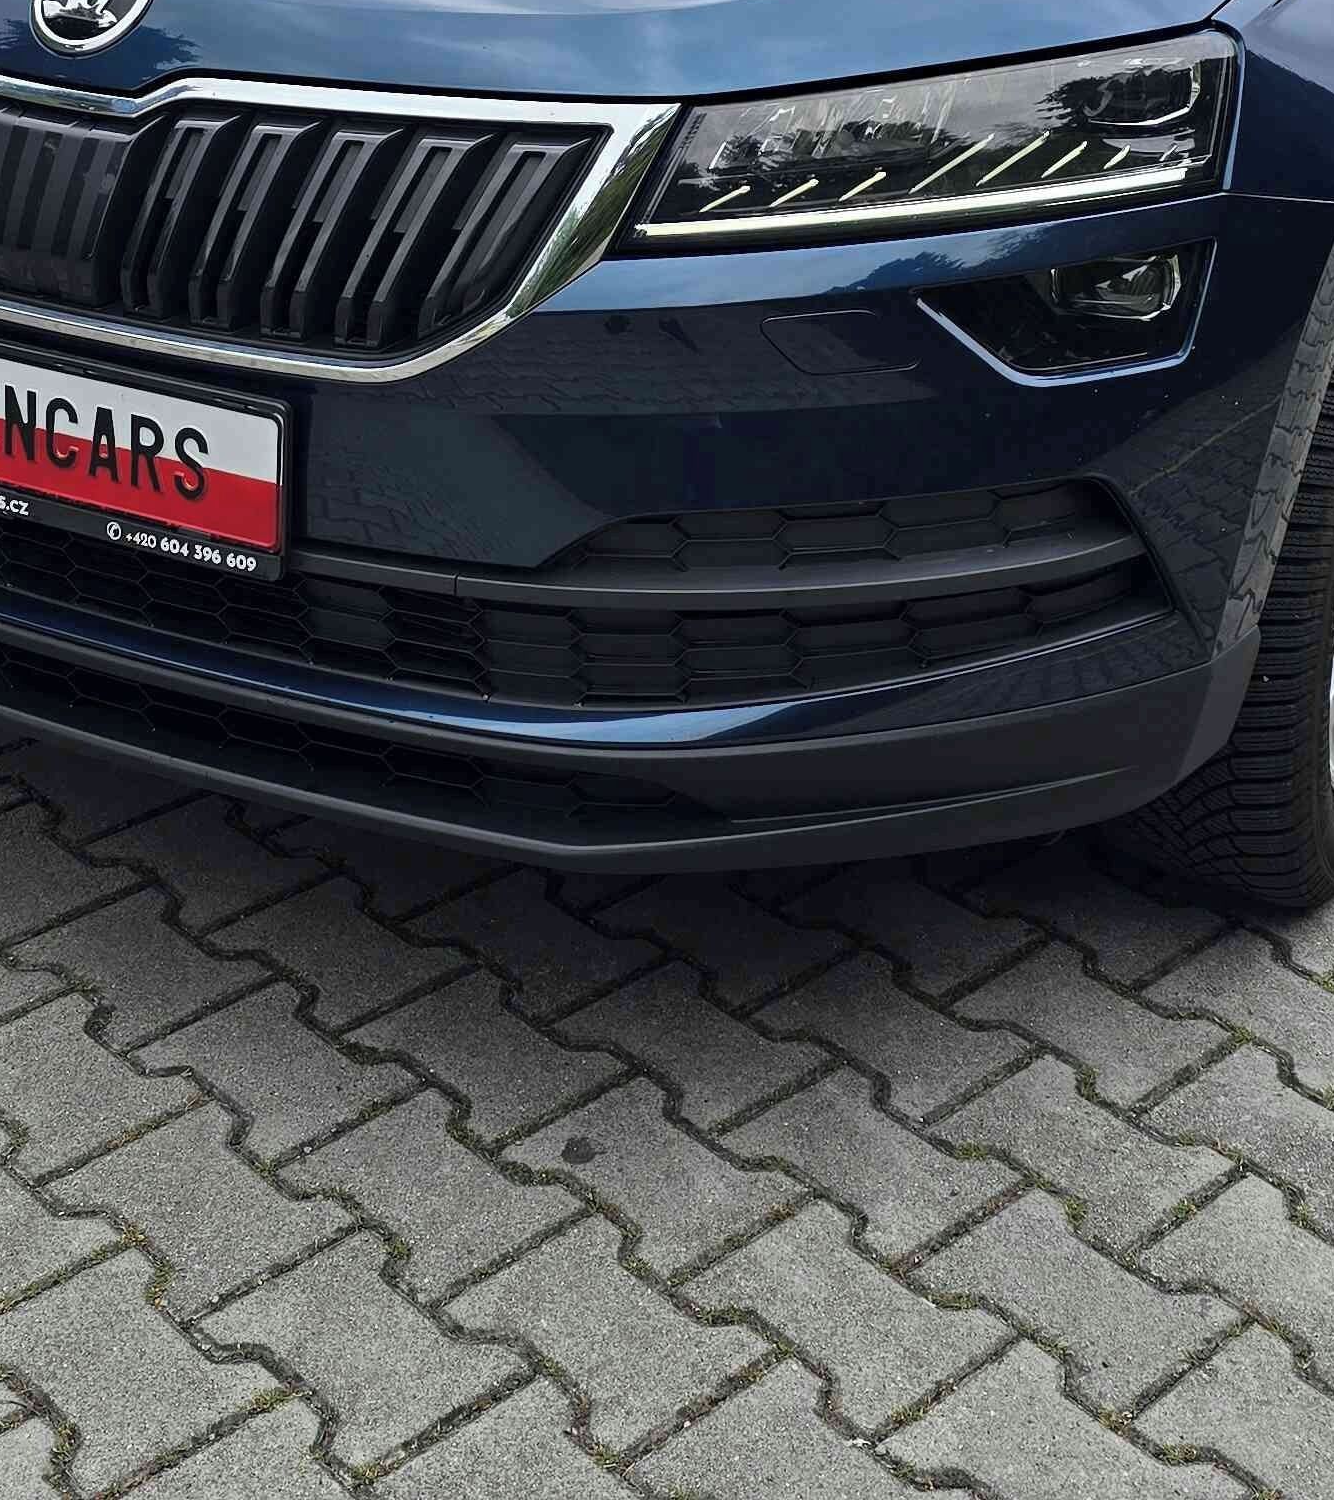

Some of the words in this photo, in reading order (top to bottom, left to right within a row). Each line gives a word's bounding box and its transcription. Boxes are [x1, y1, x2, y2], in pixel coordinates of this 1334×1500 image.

[125, 531, 157, 549] +420
[160, 536, 190, 557] 604
[193, 544, 222, 565] 396
[226, 552, 257, 572] 609
